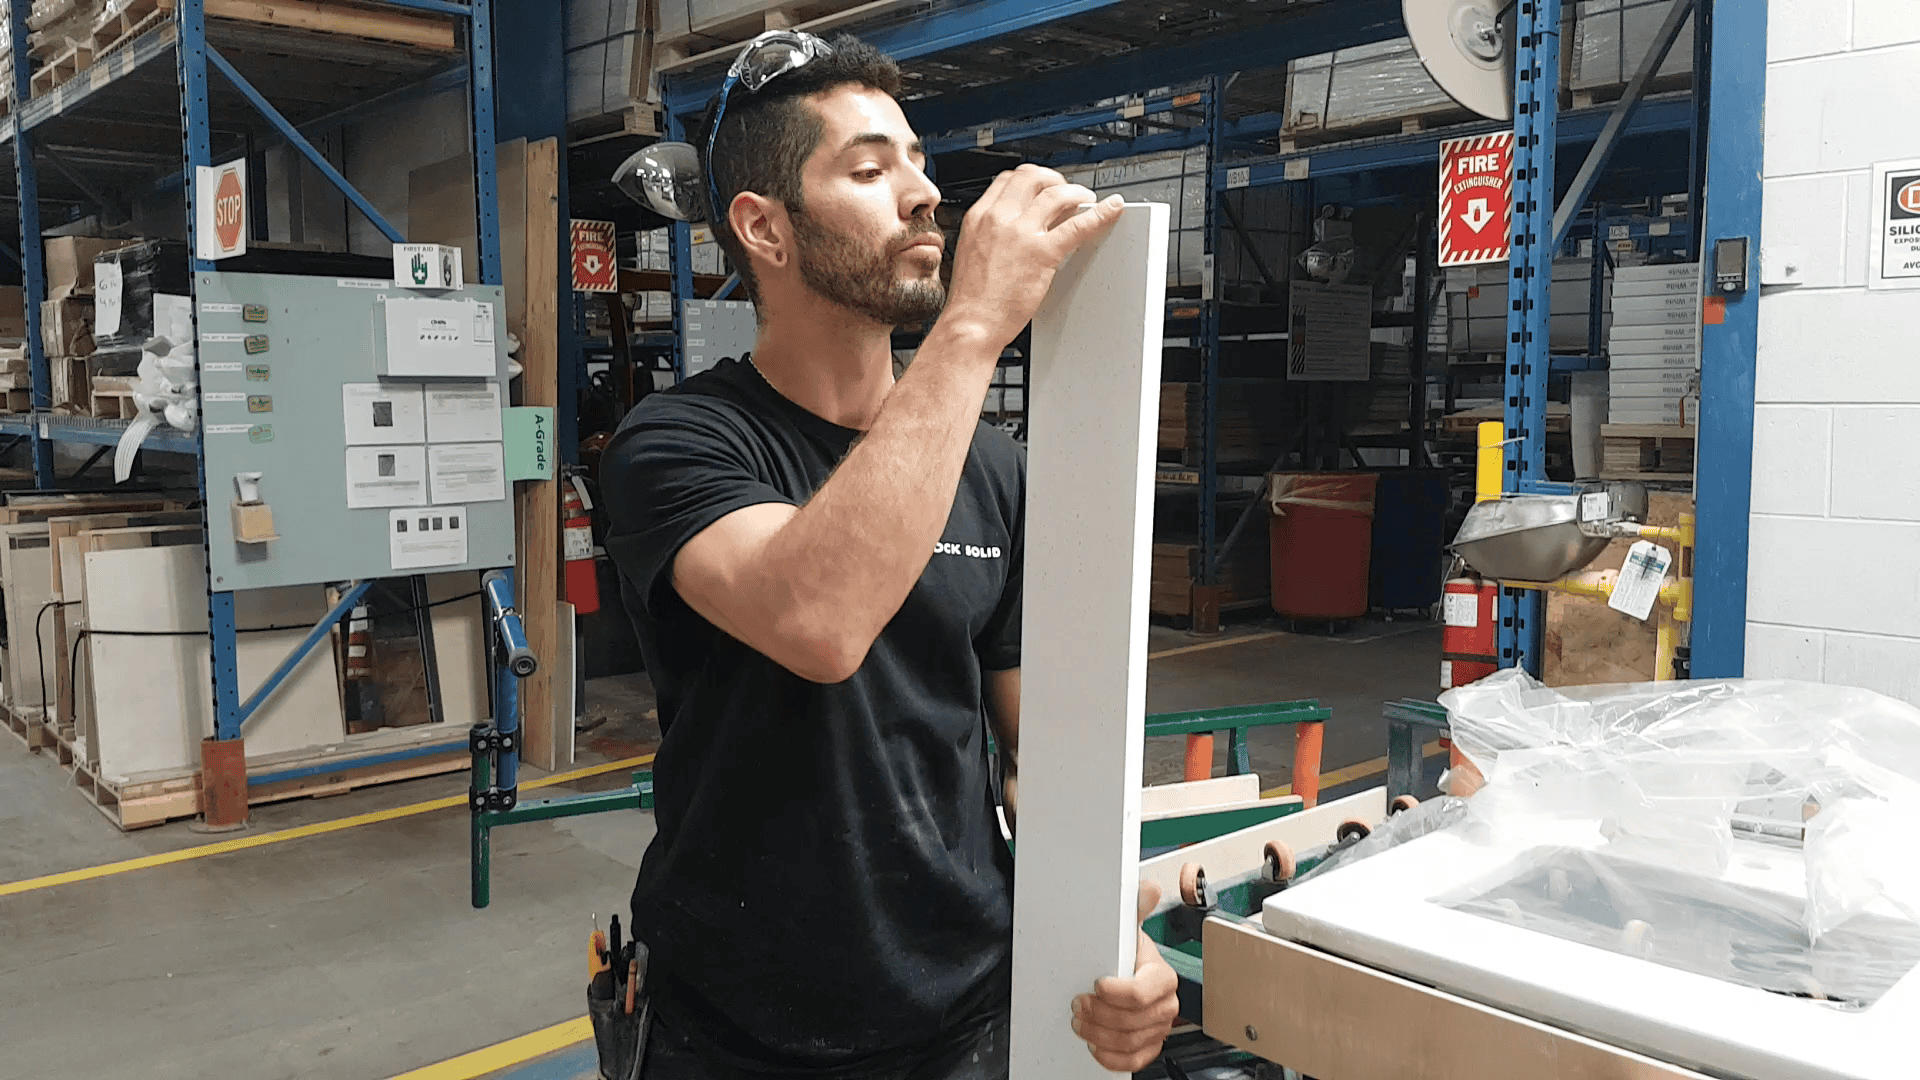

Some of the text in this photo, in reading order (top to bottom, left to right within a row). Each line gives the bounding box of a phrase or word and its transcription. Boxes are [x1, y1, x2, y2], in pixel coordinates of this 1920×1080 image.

[1458, 153, 1500, 175] FIRE
[1453, 176, 1504, 195] EXTINGUISHER
[217, 194, 241, 227] STOP
[578, 230, 605, 243] FIRE
[535, 414, 547, 471] A-Grade
